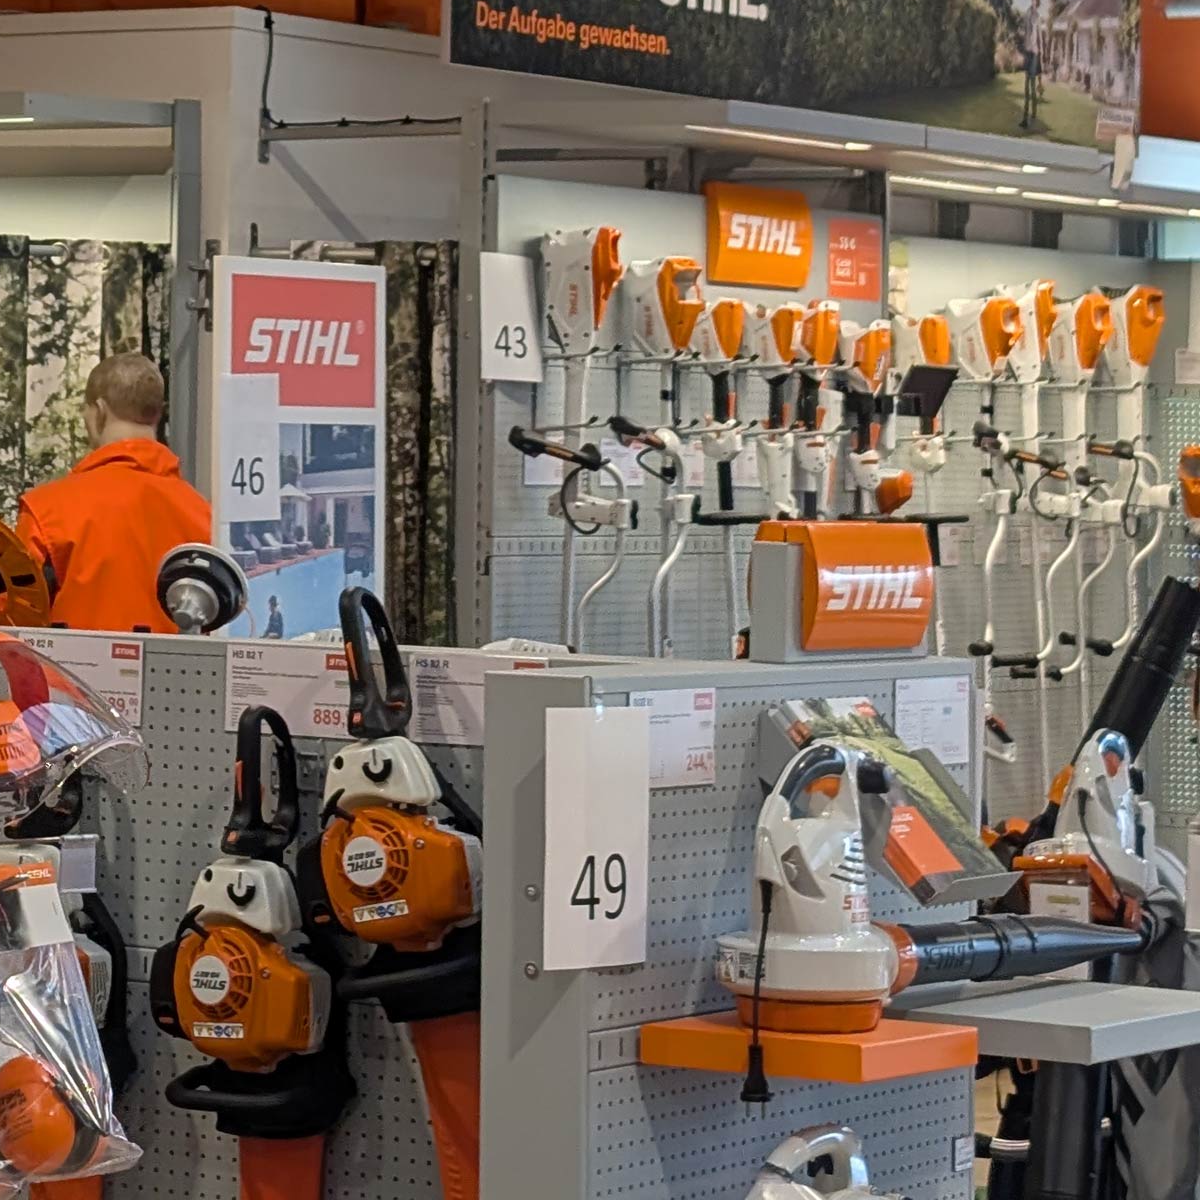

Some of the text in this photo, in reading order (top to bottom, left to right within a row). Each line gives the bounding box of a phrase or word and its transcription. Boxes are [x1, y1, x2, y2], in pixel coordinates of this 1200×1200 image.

[475, 0, 671, 55] Der Aufgabe gewachsen.
[727, 213, 802, 256] STIHL
[244, 317, 360, 366] STIHL
[494, 325, 528, 359] 43
[231, 456, 265, 496] 46
[826, 565, 923, 610] STIHL
[347, 856, 384, 874] STIHL
[570, 852, 628, 922] 49
[192, 978, 227, 991] STIHL
